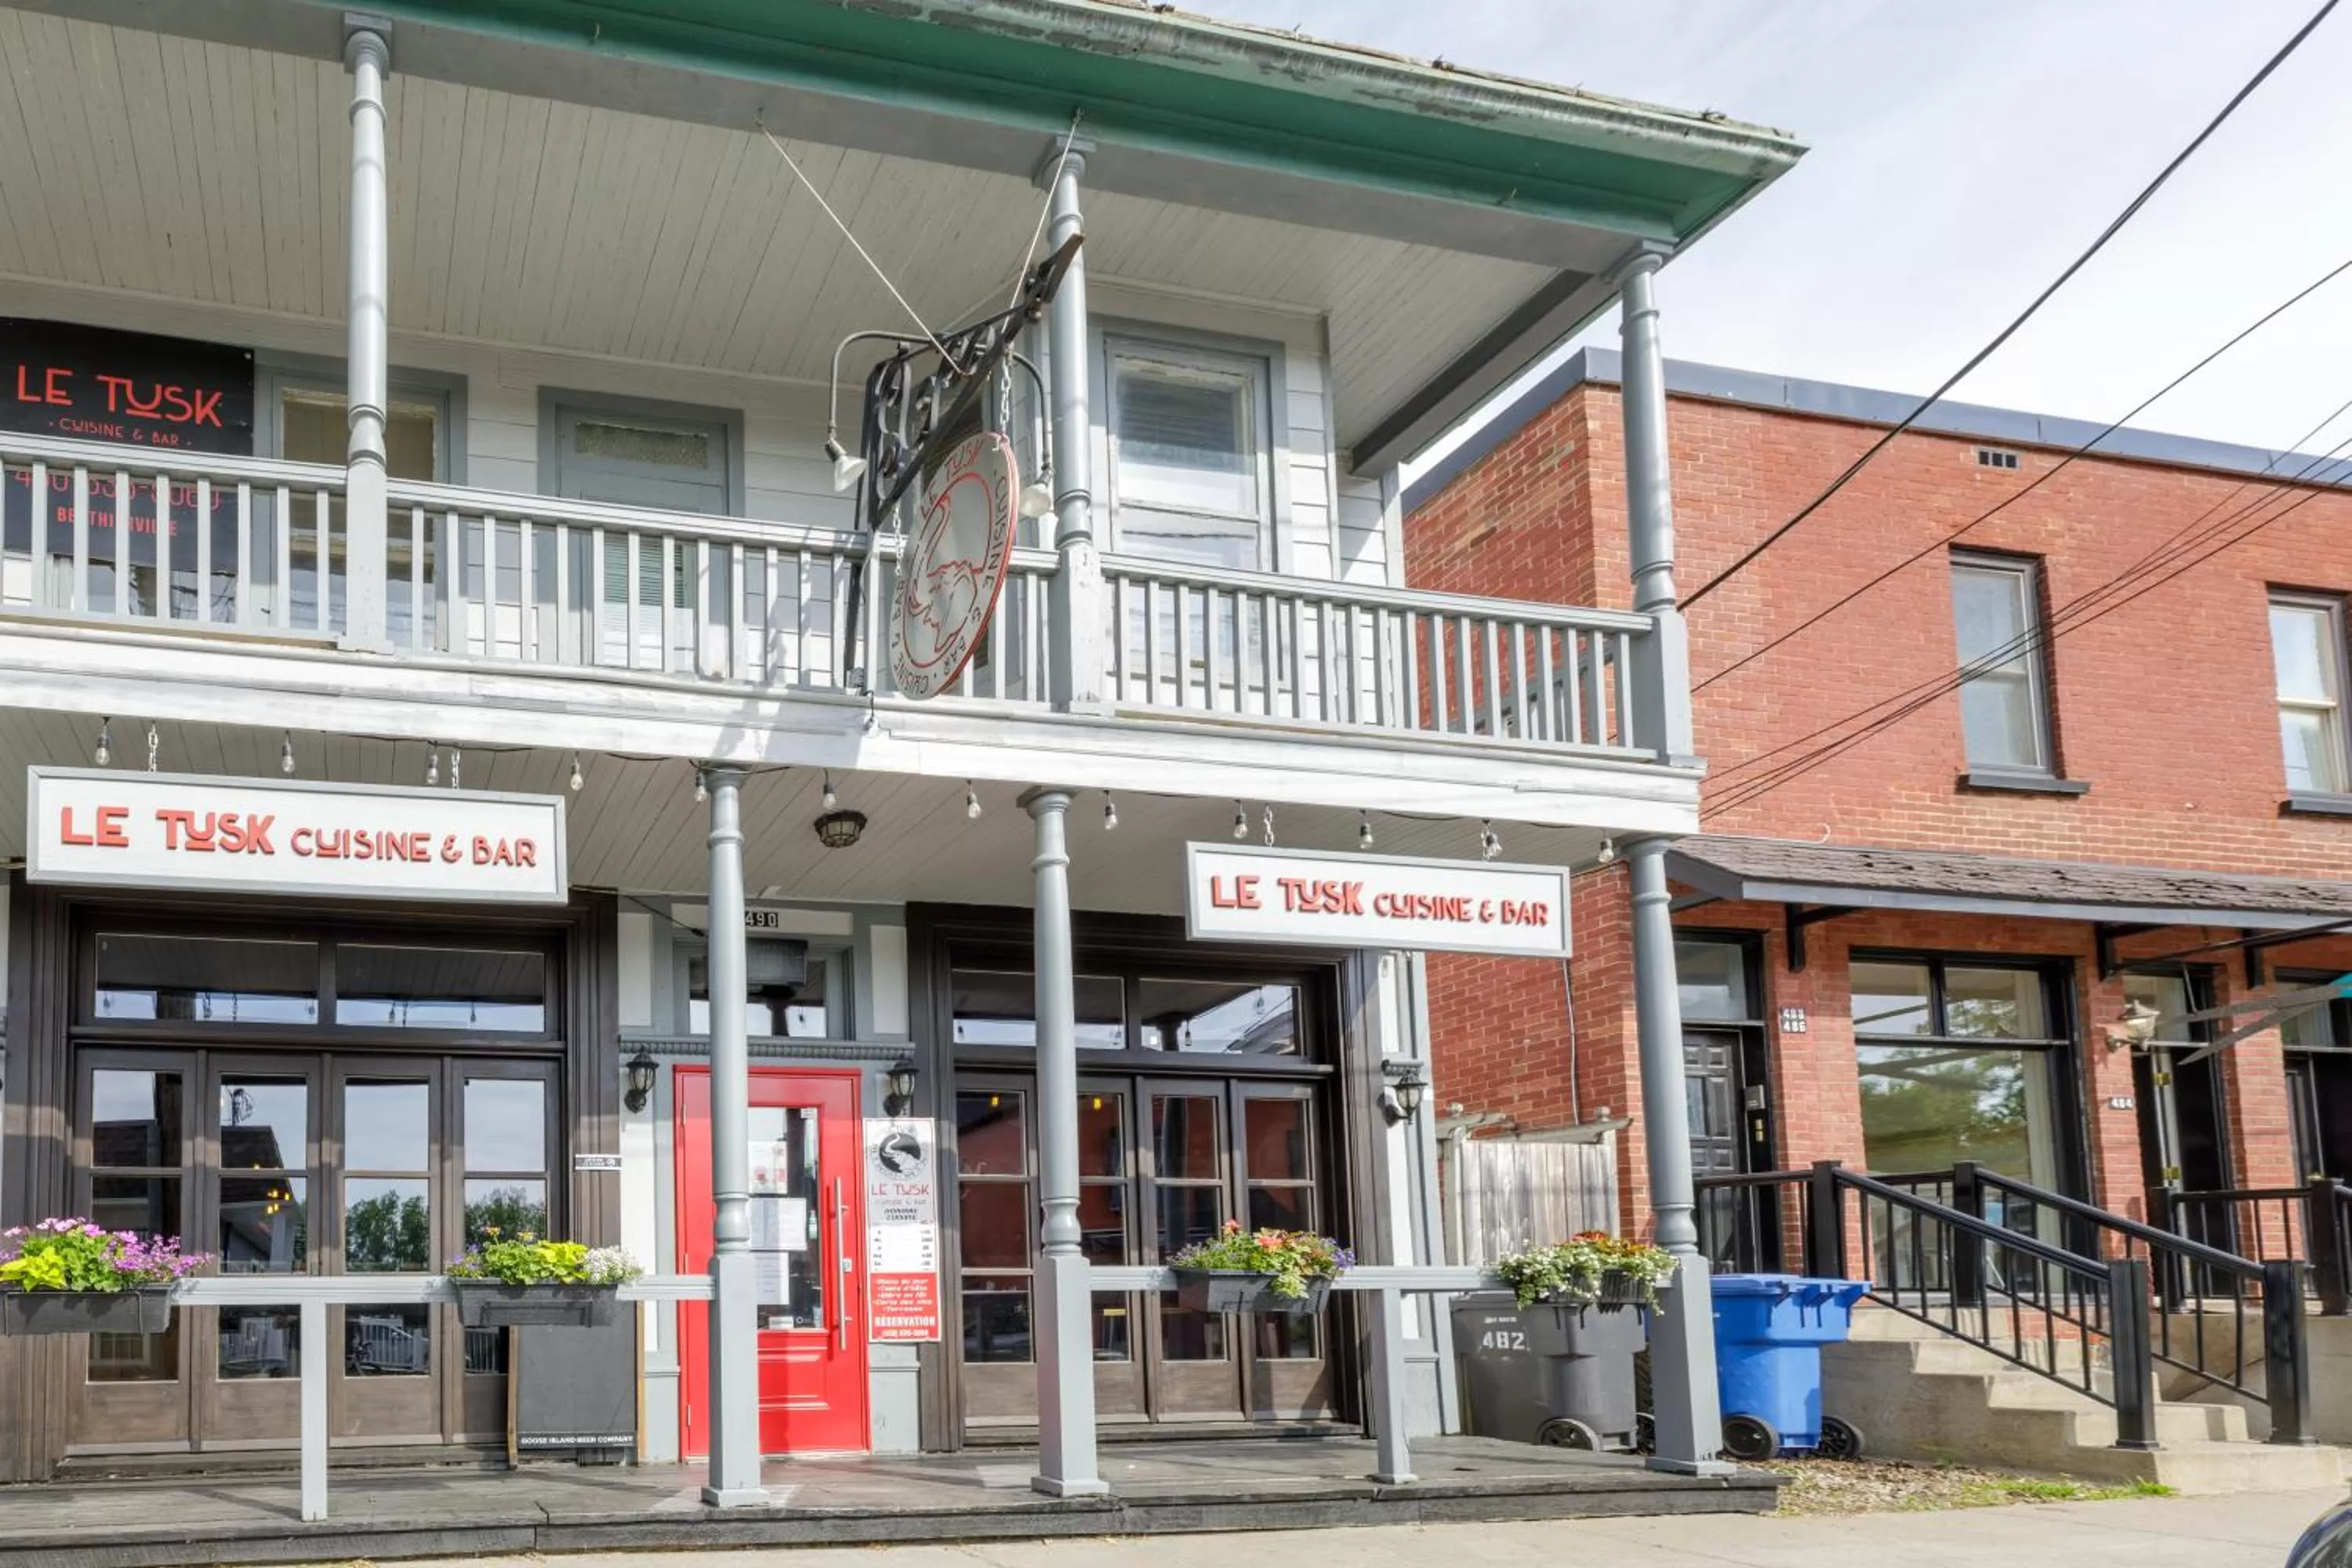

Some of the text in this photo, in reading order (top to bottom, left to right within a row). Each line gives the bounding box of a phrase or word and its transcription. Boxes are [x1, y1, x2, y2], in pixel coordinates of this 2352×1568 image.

[17, 365, 223, 428] LE TUSK
[58, 418, 180, 446] CUISINE & BAR
[60, 805, 538, 868] LE TUSK CUISINE & BAR
[746, 913, 778, 926] 490
[1210, 875, 1549, 927] LE TUSK CUISINE & BAR
[871, 1183, 929, 1196] LE TUSK
